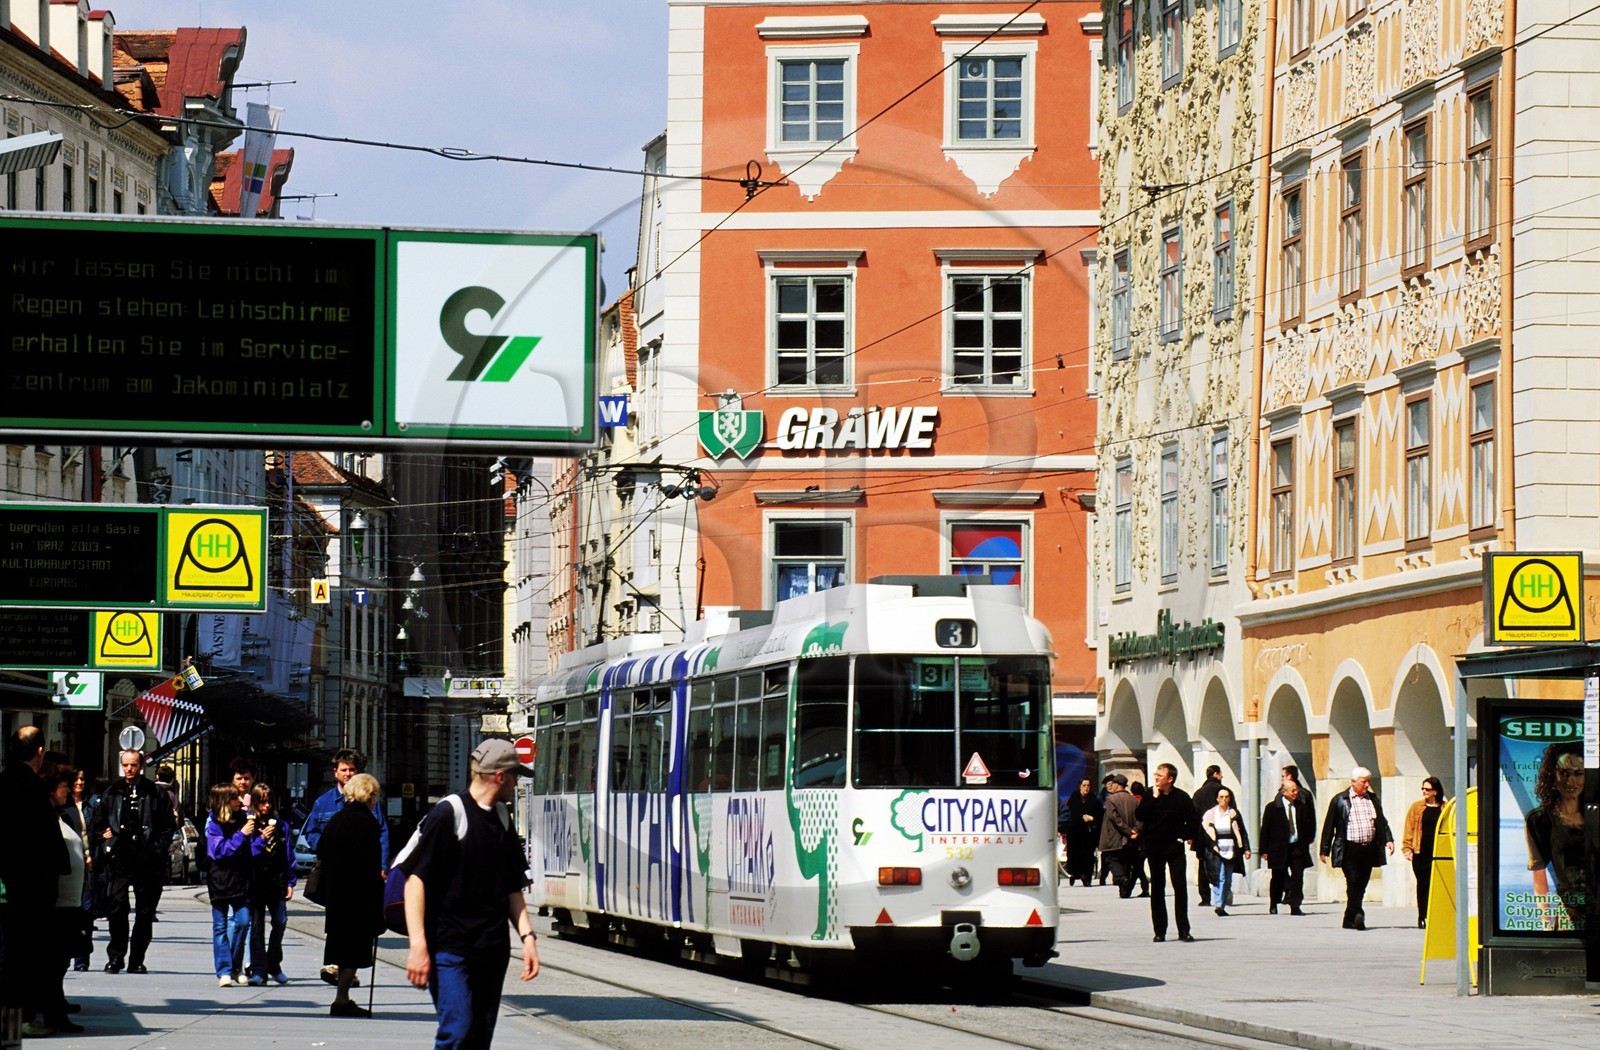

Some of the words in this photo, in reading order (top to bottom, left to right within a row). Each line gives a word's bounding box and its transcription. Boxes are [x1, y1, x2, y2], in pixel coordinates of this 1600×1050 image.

[12, 257, 56, 276] Wir
[74, 256, 156, 280] lassen
[171, 259, 213, 280] Sie
[226, 261, 292, 285] nicht
[313, 264, 338, 285] im
[11, 291, 82, 319] Regen
[197, 297, 351, 323] Leihschirme
[11, 332, 126, 355] erhalten
[140, 335, 182, 356] Sie
[199, 337, 224, 358] im
[11, 371, 110, 394] zentrum
[126, 376, 153, 393] am
[172, 372, 350, 401] Jakominiplatz
[599, 400, 625, 423] W
[776, 406, 938, 450] GRAWE
[71, 541, 100, 552] 2003
[197, 534, 231, 558] HH
[316, 584, 326, 599] A
[355, 590, 366, 603] T
[1520, 574, 1553, 598] HH
[115, 620, 139, 636] HH
[949, 621, 962, 646] 3
[924, 667, 938, 683] 3
[921, 797, 1028, 834] CITYPARK
[931, 836, 1025, 845] INTERKAUF
[946, 847, 973, 860] 532
[1505, 905, 1568, 918] Citypark
[1505, 917, 1555, 931] Anger,
